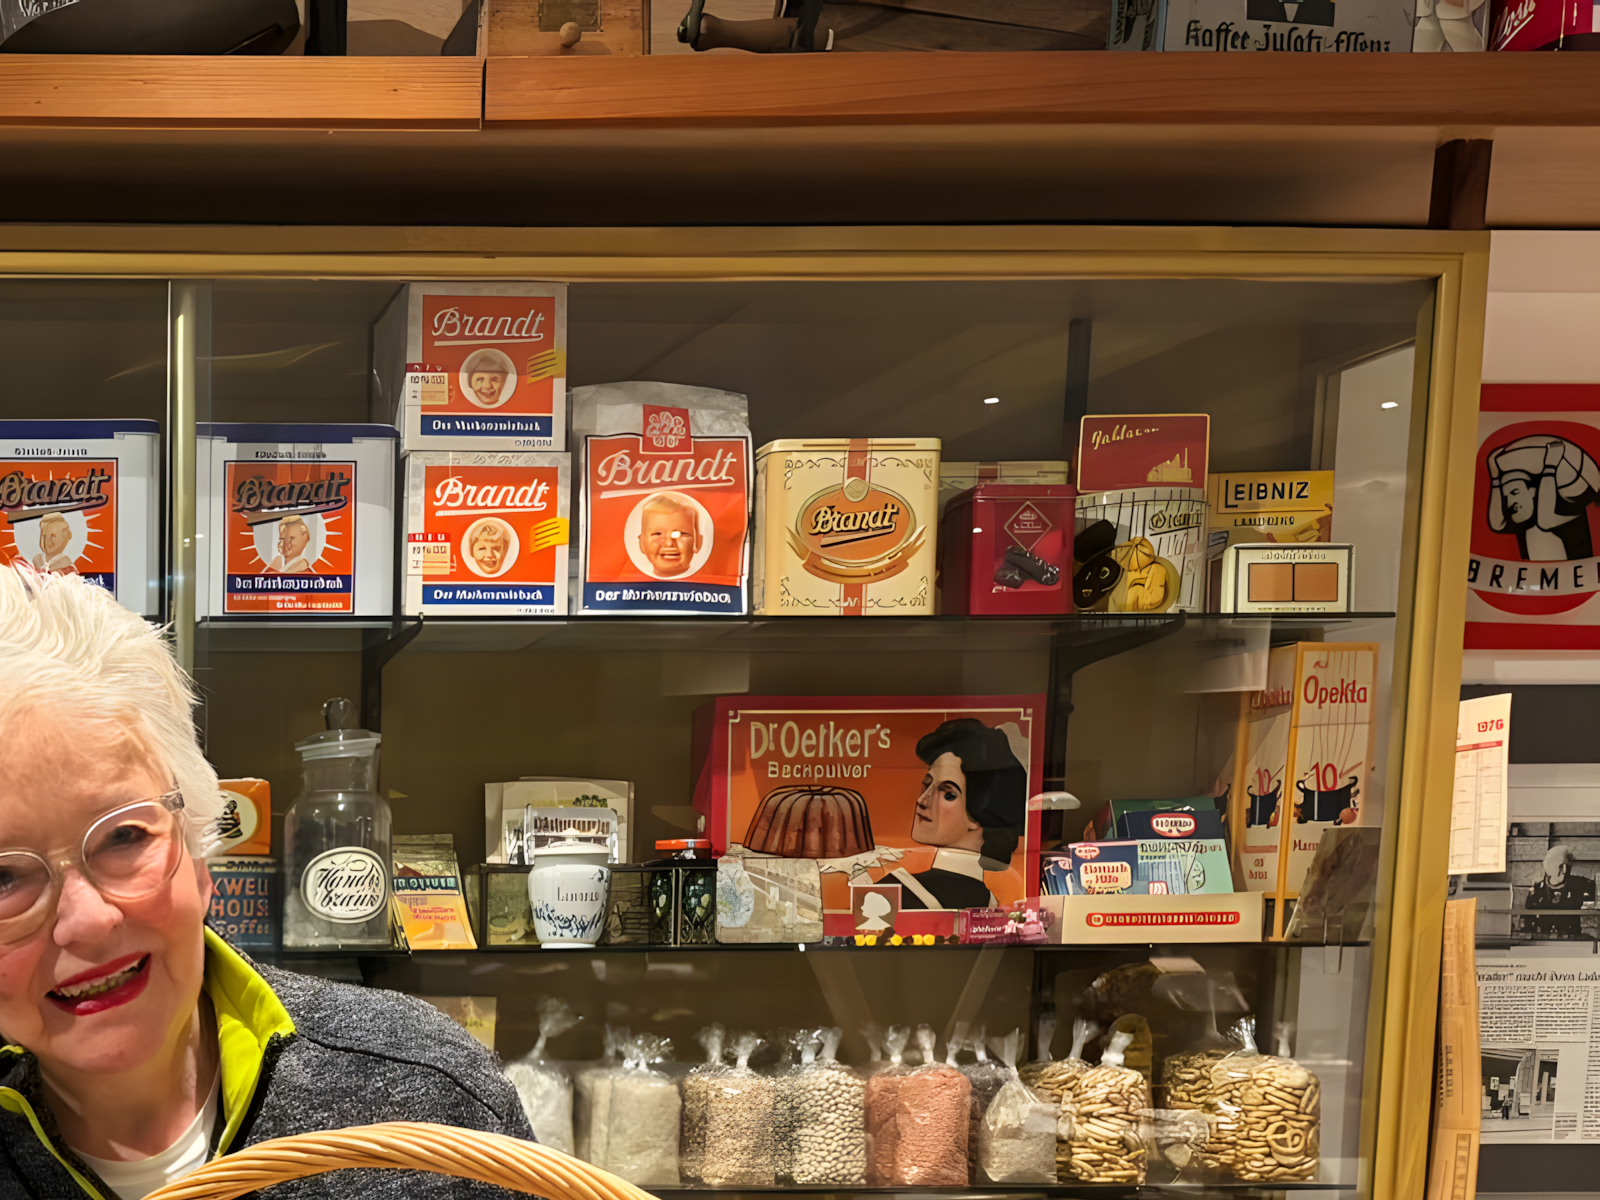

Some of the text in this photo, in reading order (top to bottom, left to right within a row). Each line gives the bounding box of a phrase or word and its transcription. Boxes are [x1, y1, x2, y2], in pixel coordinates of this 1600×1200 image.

[431, 307, 545, 338] Brandt
[597, 449, 737, 486] Brandt
[433, 476, 550, 508] Brandt
[1224, 479, 1310, 509] LEIBNIZ
[808, 503, 900, 536] Brandt
[1467, 559, 1600, 591] BREME
[1303, 675, 1368, 709] Opekta
